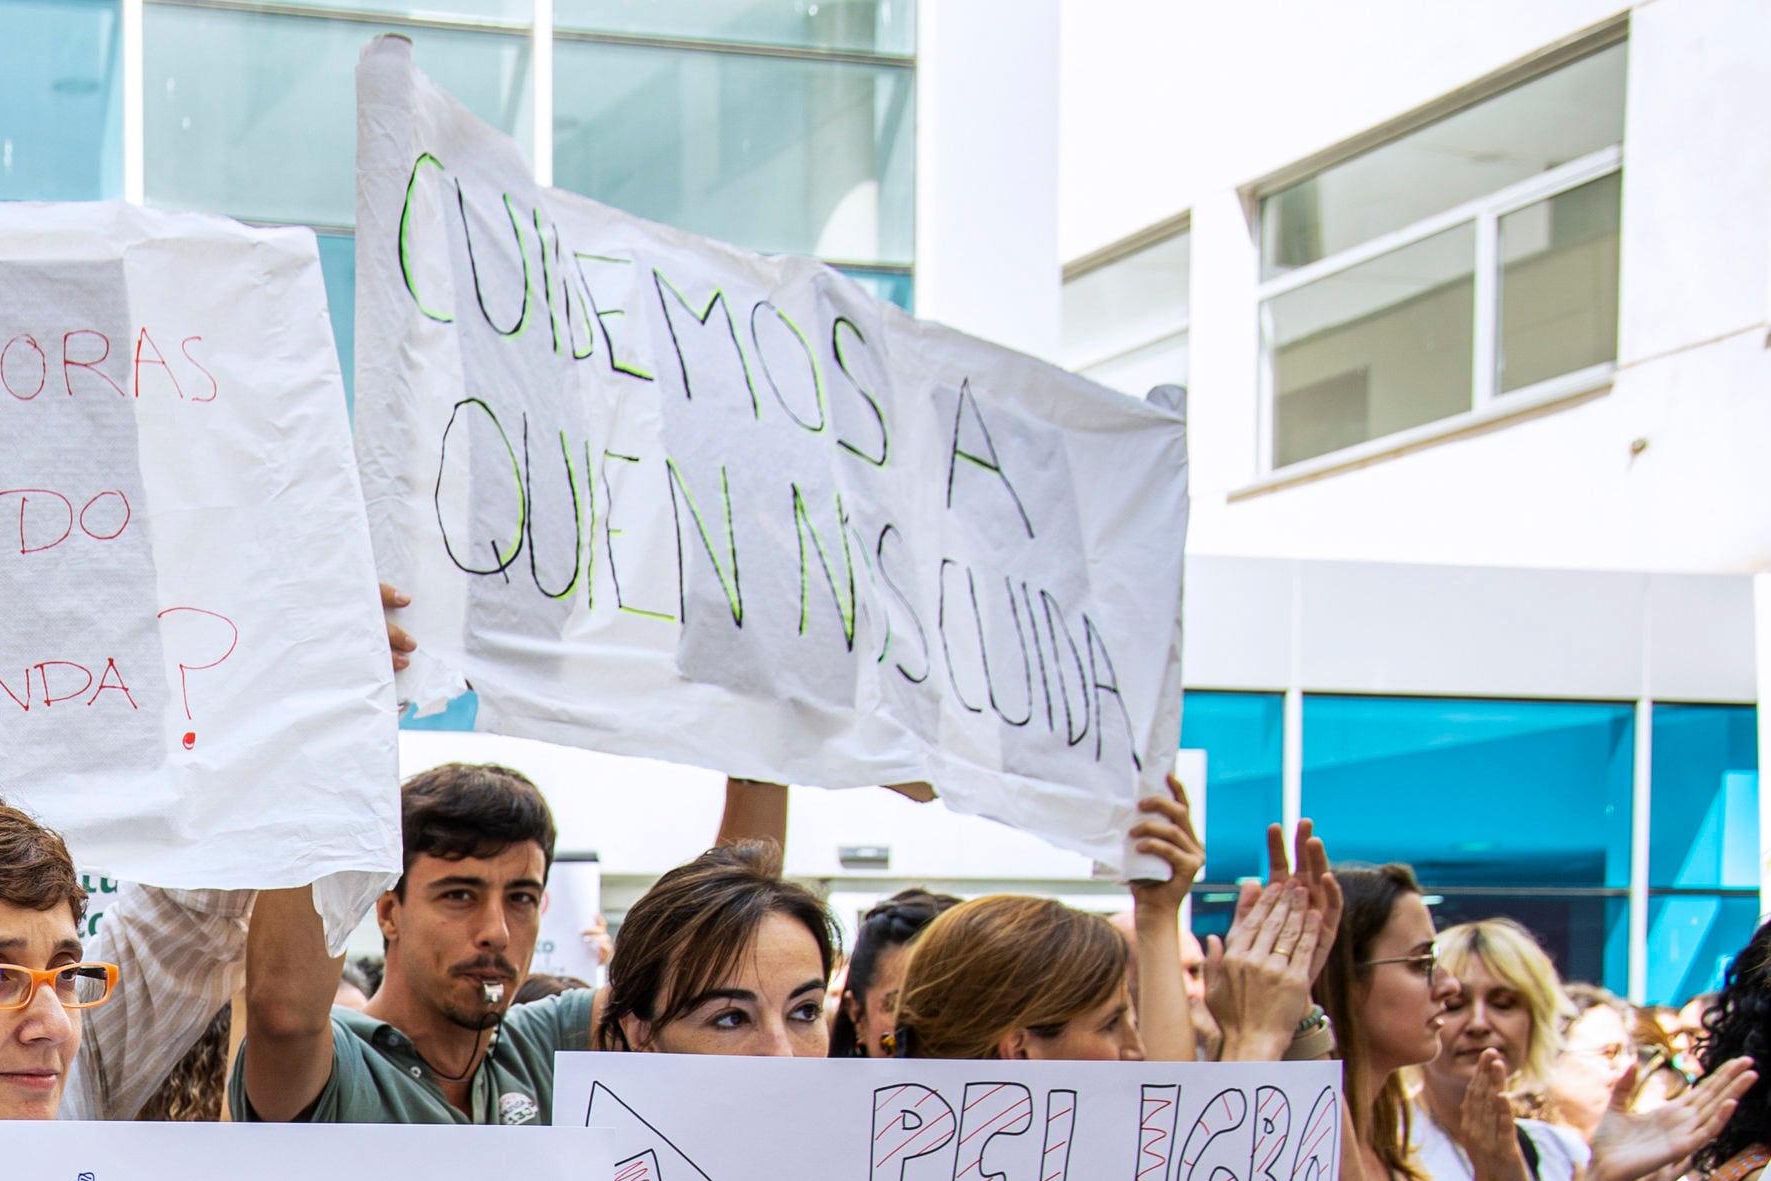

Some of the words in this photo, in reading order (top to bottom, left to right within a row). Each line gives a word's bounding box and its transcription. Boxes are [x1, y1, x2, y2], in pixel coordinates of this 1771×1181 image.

[434, 397, 744, 629] QUIEN
[938, 557, 1143, 772] CUIDA
[947, 376, 1035, 539] A
